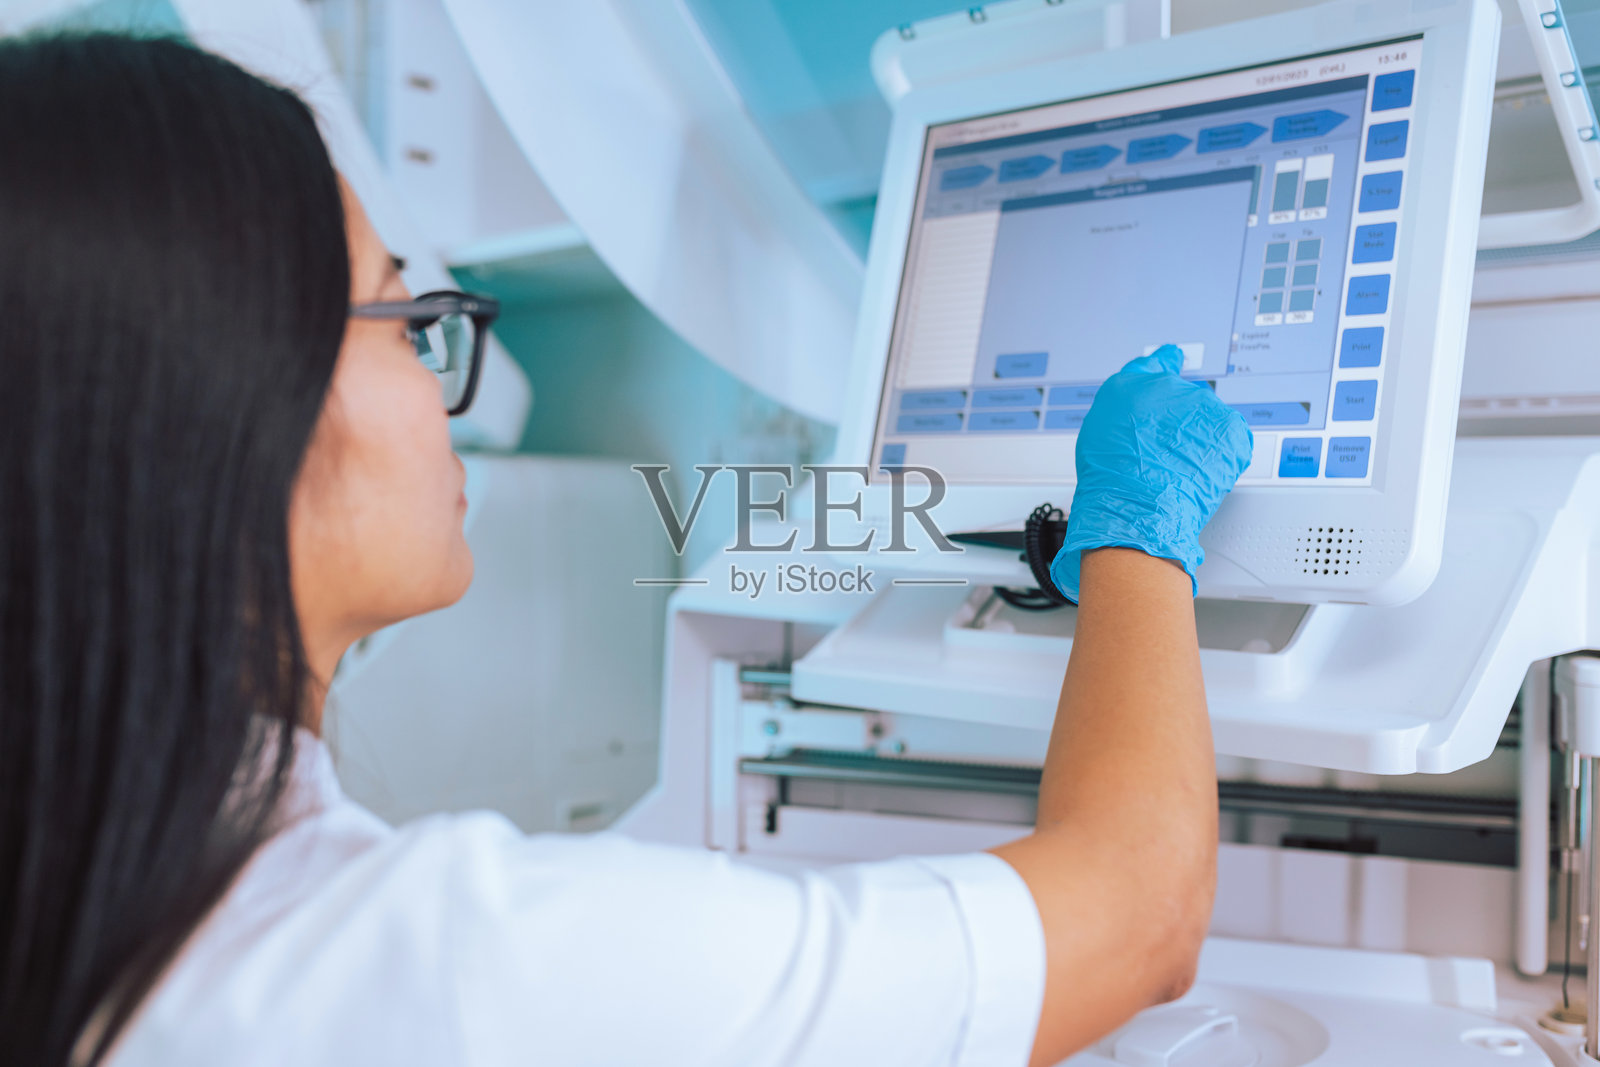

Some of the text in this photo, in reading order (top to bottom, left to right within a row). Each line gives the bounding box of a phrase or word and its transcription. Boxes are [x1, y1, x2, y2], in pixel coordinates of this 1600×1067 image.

[1352, 343, 1371, 351] Print
[1345, 396, 1365, 404] Start
[1332, 445, 1366, 453] Remove
[1287, 454, 1314, 462] Screen
[1338, 454, 1357, 462] USB
